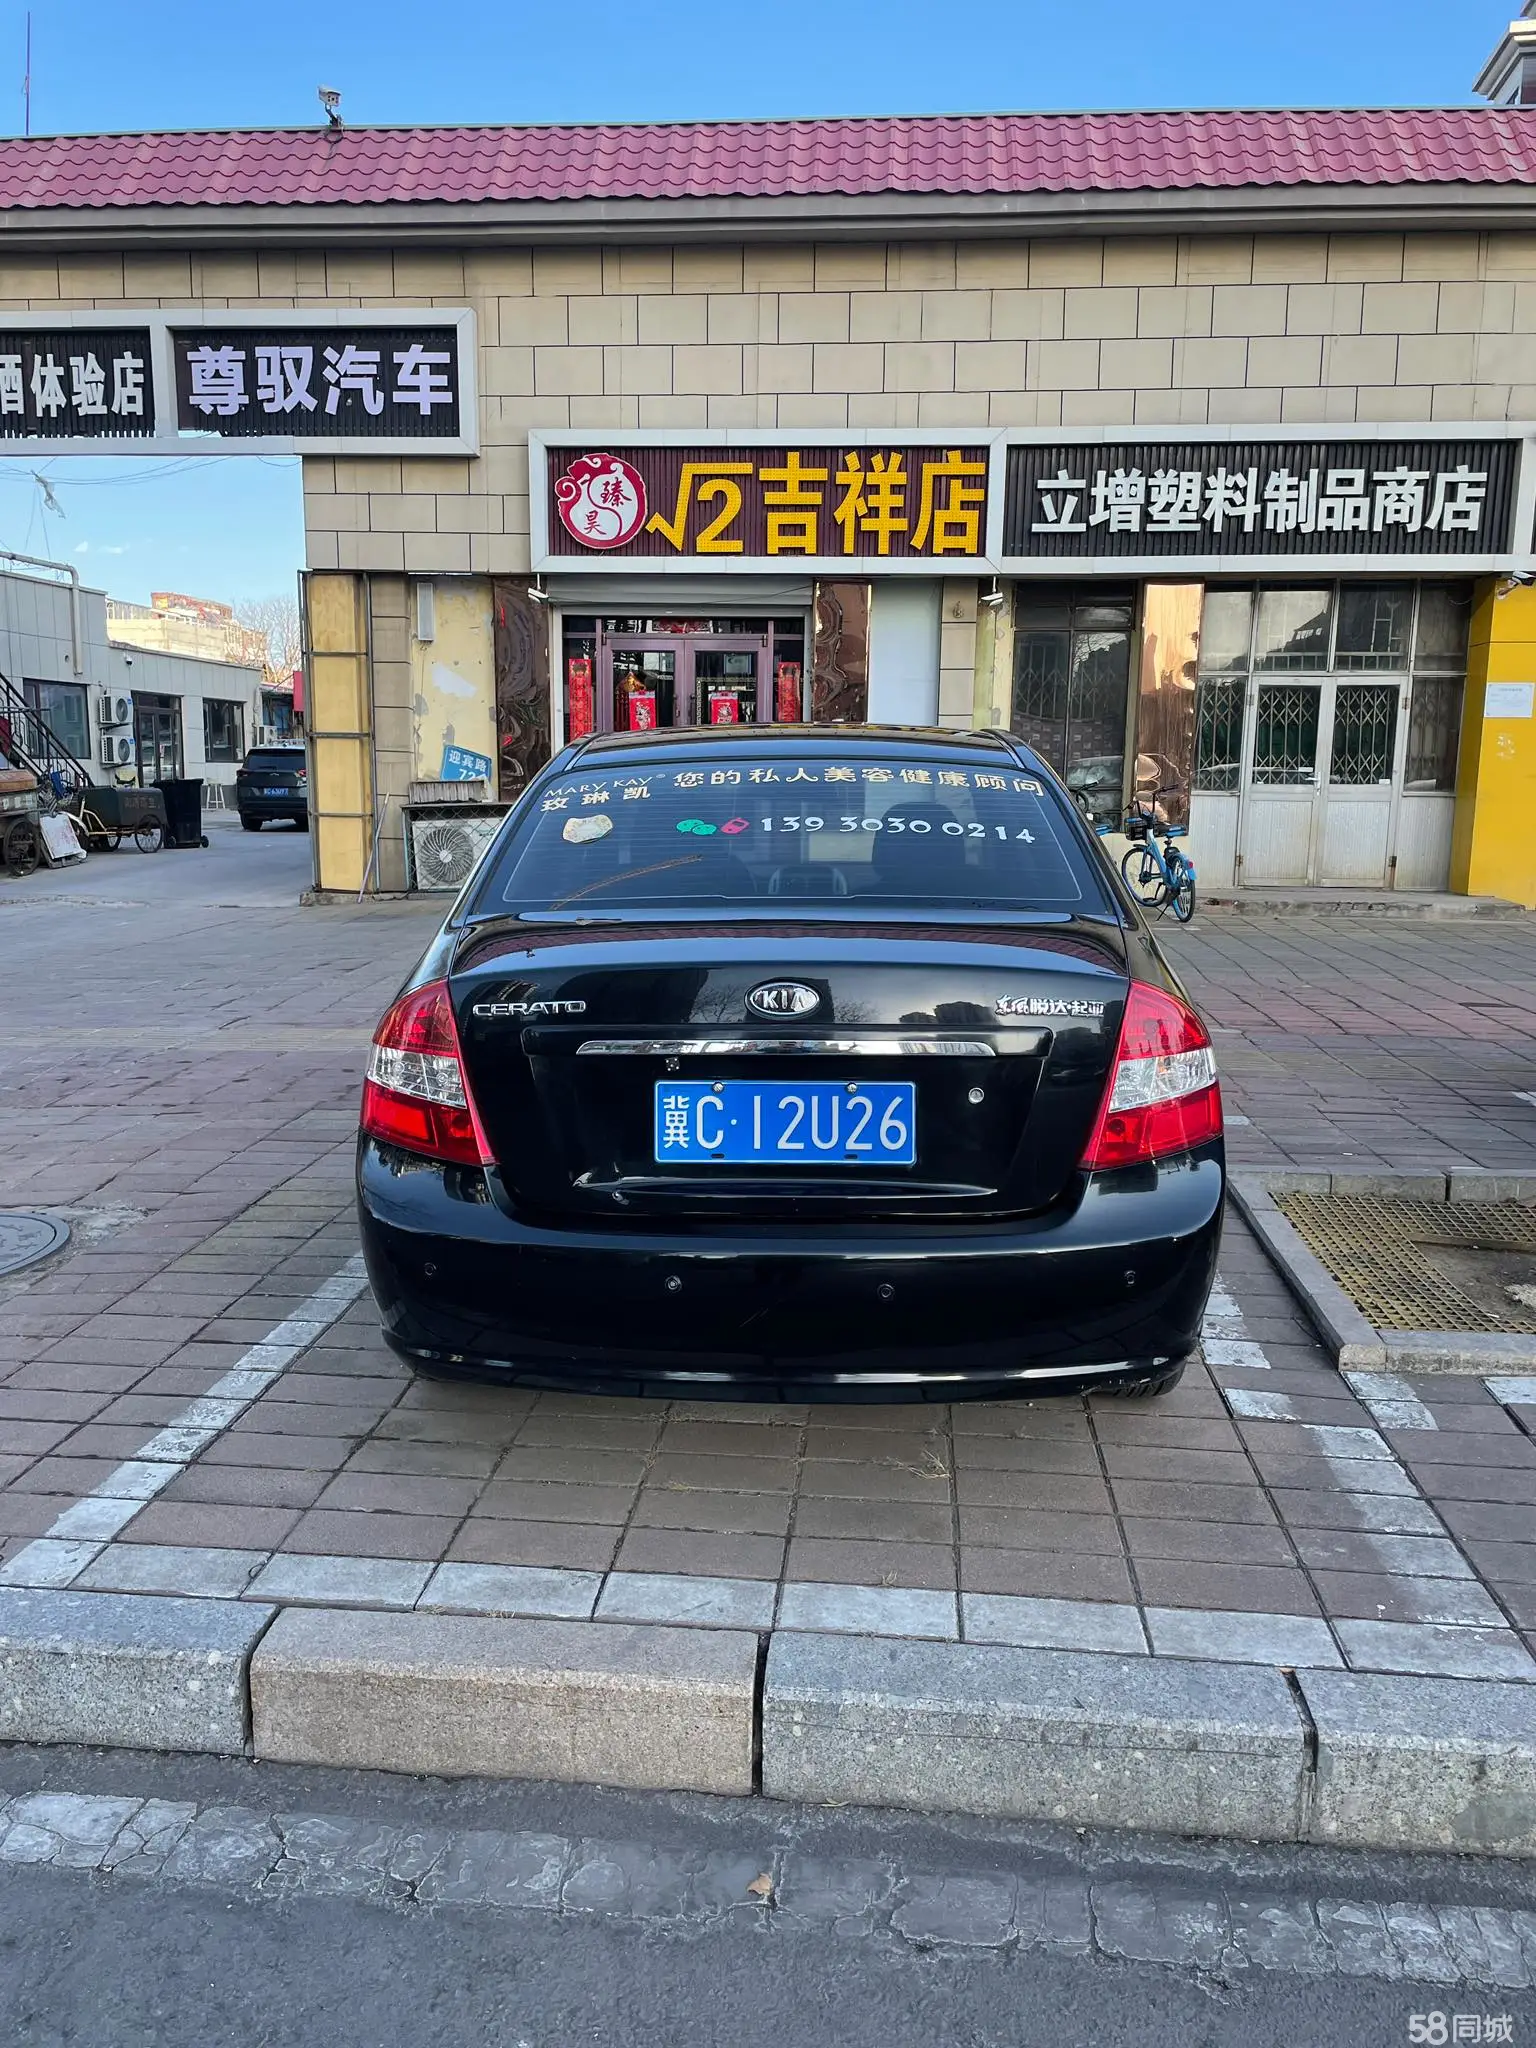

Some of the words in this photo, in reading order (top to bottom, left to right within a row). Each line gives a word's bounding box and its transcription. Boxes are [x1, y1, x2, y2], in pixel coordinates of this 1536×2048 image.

[186, 343, 454, 416] 尊驭汽车
[1031, 464, 1488, 534] 立增塑料制品商店
[449, 750, 487, 773] 迎宾路
[544, 781, 607, 798] MARY
[672, 766, 1045, 797] 您的私人美容健康顾问
[540, 786, 651, 812] 玫琳凯
[760, 816, 825, 832] 139
[838, 817, 932, 834] 3030
[941, 822, 1036, 844] 0214
[472, 1000, 587, 1016] CERATO
[762, 988, 806, 1010] KIA
